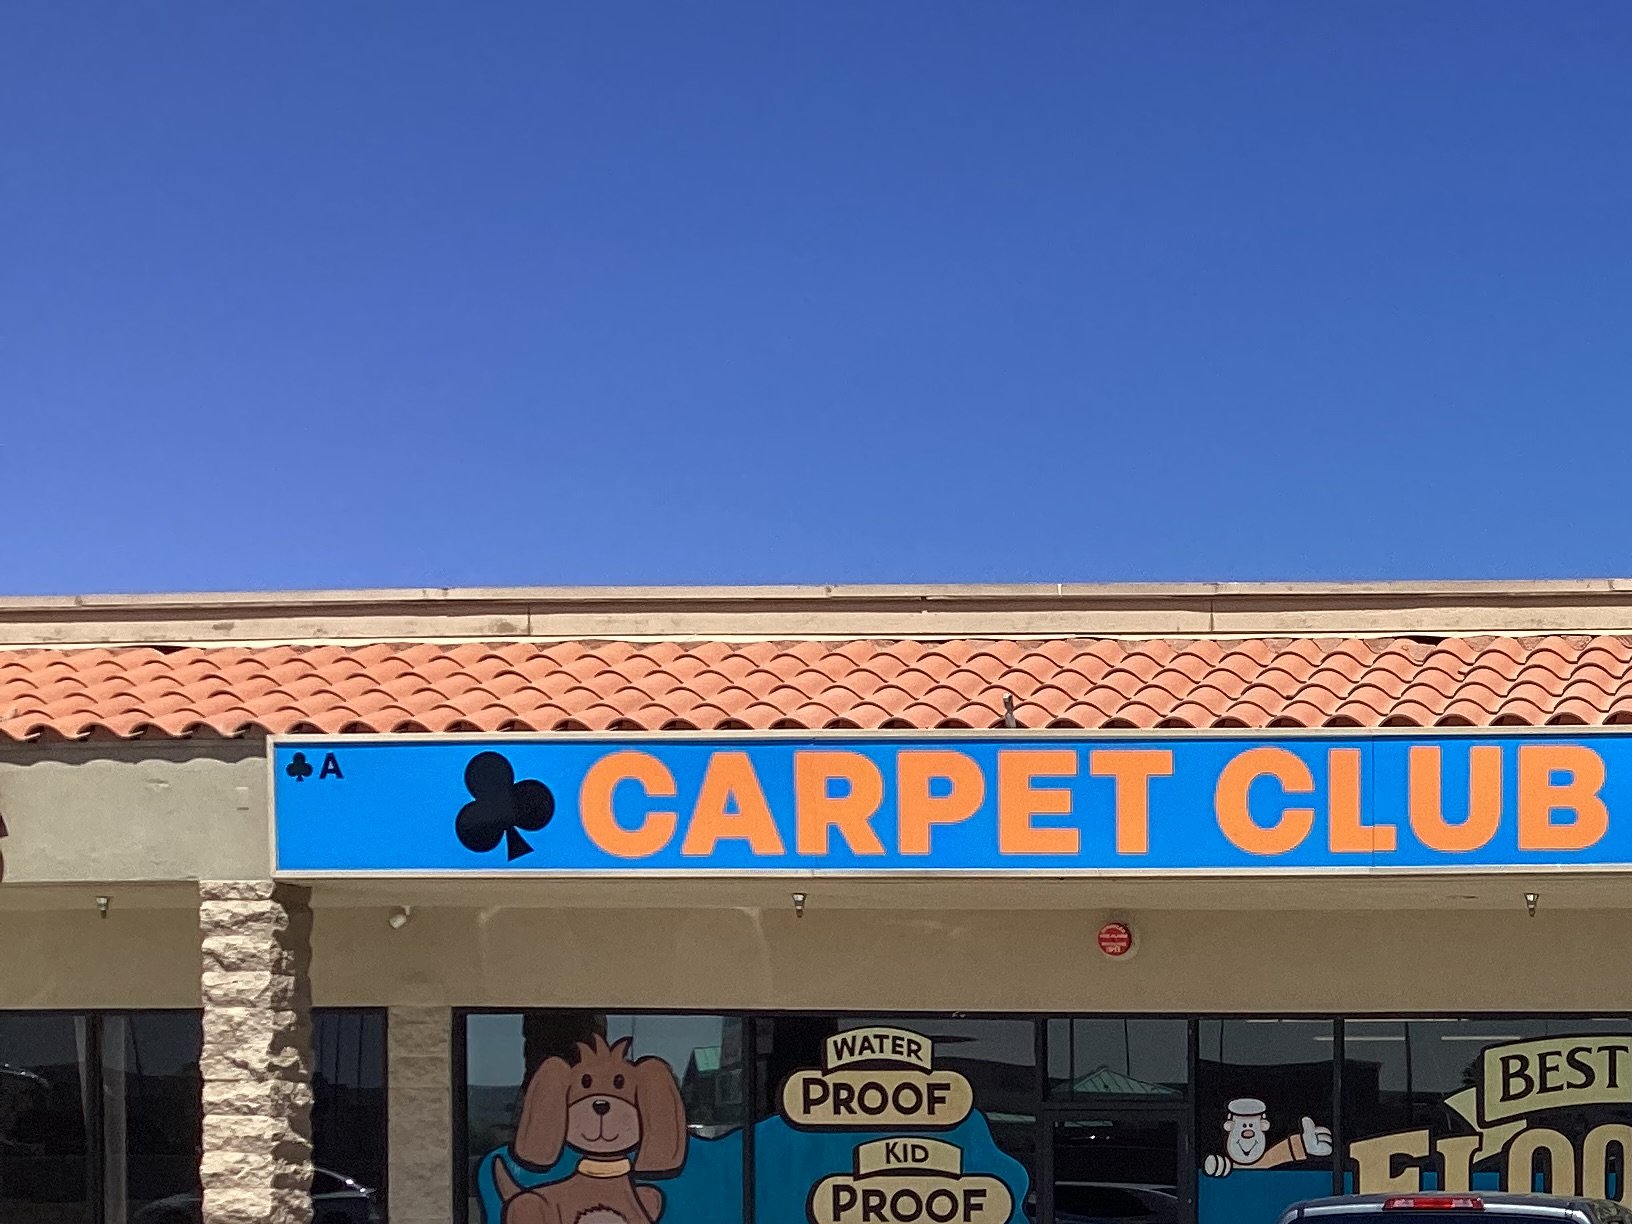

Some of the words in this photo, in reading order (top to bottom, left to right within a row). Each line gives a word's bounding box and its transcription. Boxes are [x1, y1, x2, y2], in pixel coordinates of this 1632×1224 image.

[319, 752, 344, 780] A
[579, 748, 1175, 857] CARPET
[1215, 746, 1610, 856] CLUB
[832, 1033, 924, 1063] WATER
[801, 1076, 952, 1117] PROOF
[884, 1140, 930, 1165] KID
[831, 1183, 989, 1224] PROOF
